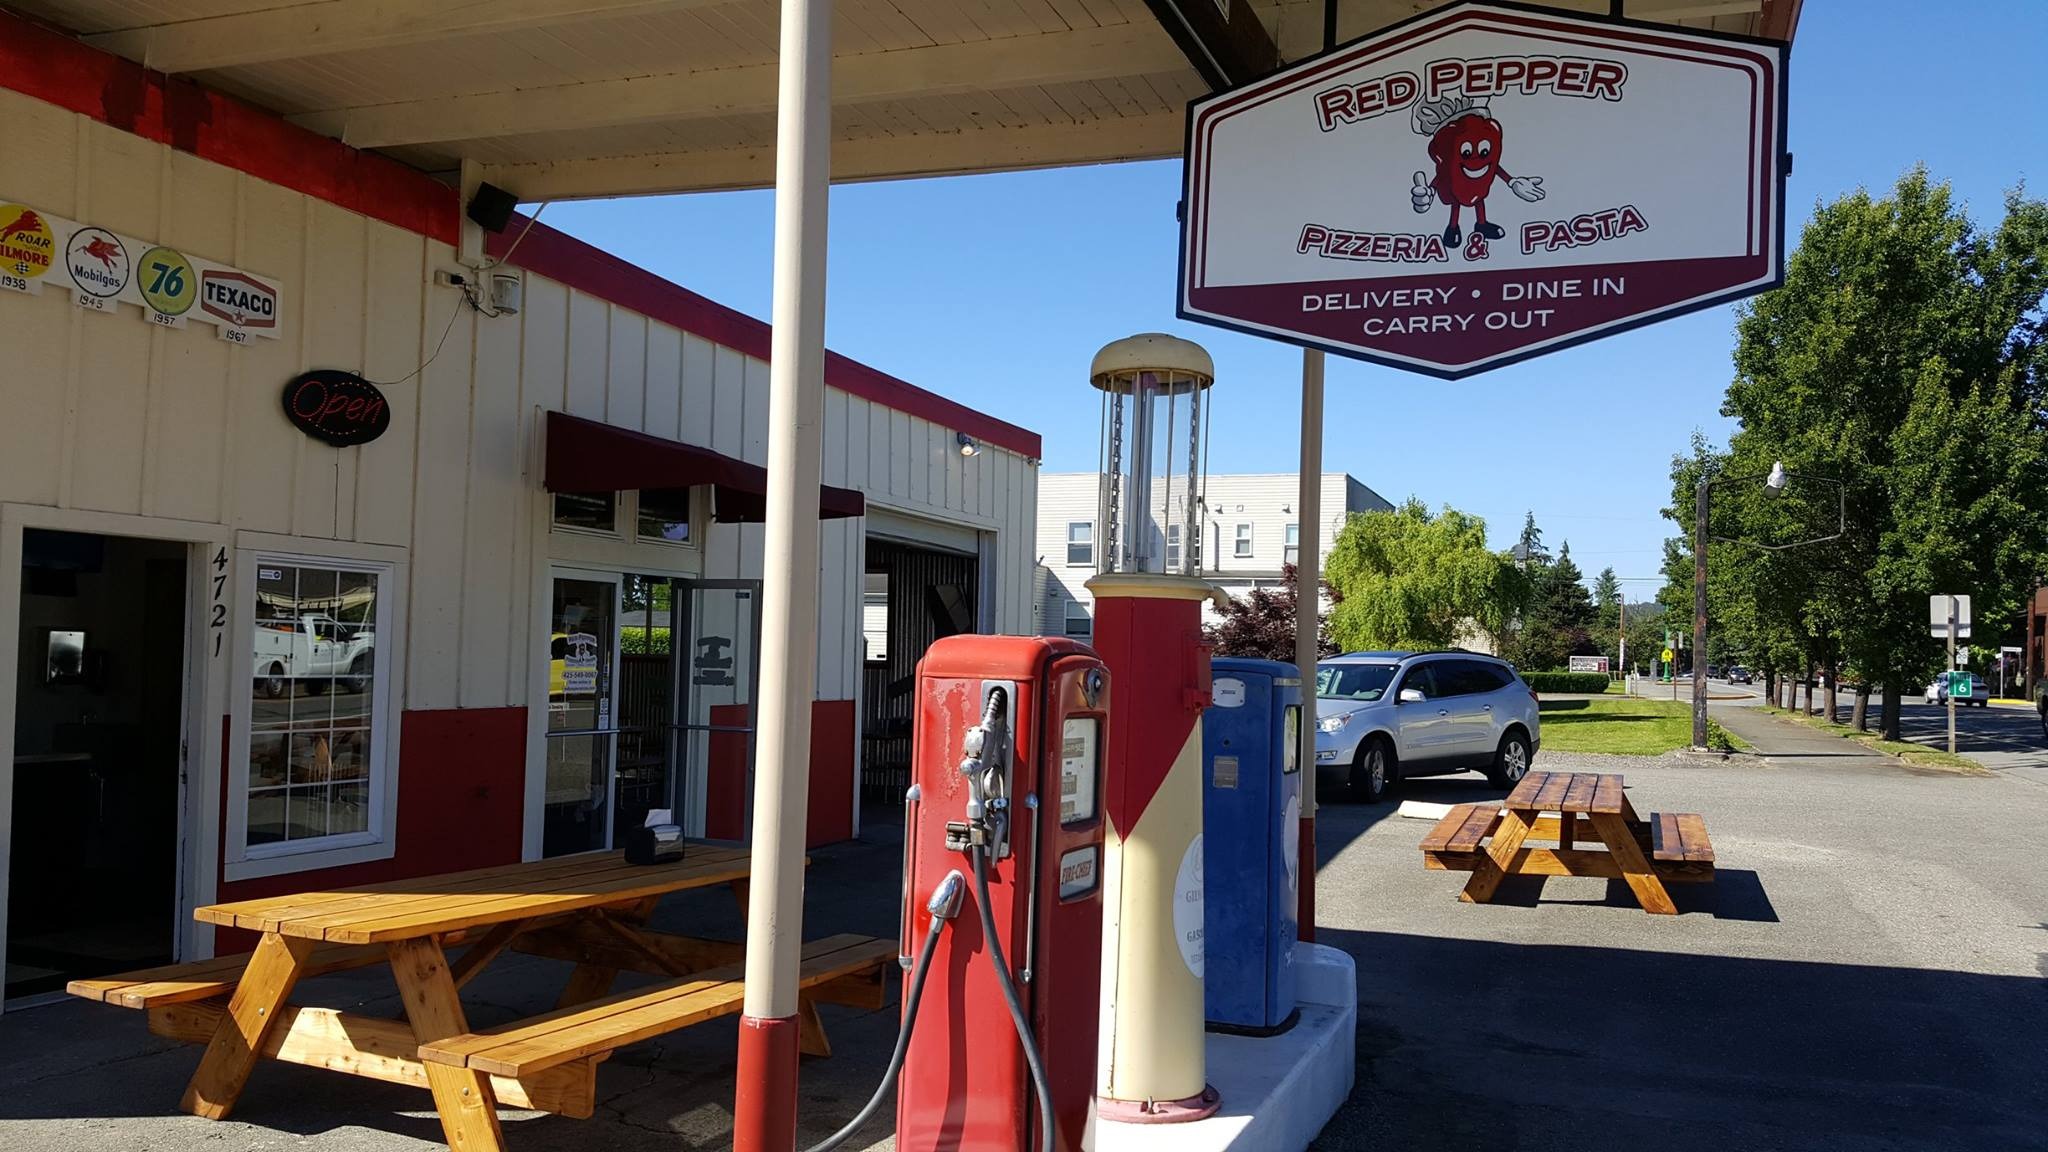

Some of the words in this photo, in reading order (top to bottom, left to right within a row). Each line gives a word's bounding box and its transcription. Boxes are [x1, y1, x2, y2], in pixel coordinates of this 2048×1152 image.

[1316, 73, 1419, 129] RED
[1428, 58, 1626, 99] PEPPER
[15, 232, 51, 248] ROAR
[1299, 226, 1447, 261] PIZZERIA
[1464, 233, 1489, 261] &
[1523, 207, 1646, 253] PASTA
[0, 244, 49, 267] ILMORE
[2, 275, 26, 290] 1938
[74, 264, 121, 288] Mobilgas
[149, 262, 184, 296] 76
[79, 294, 103, 309] 1945
[205, 281, 272, 315] TEXACO
[1302, 287, 1457, 312] DELIVERY
[1502, 279, 1582, 301] DINE
[1592, 277, 1625, 296] IN
[153, 313, 176, 325] 1957
[1363, 313, 1475, 336] CARRY
[1484, 309, 1555, 330] OUT
[226, 328, 247, 343] 1967
[292, 381, 384, 424] Open
[210, 546, 229, 658] 4721
[1958, 683, 1967, 692] 6
